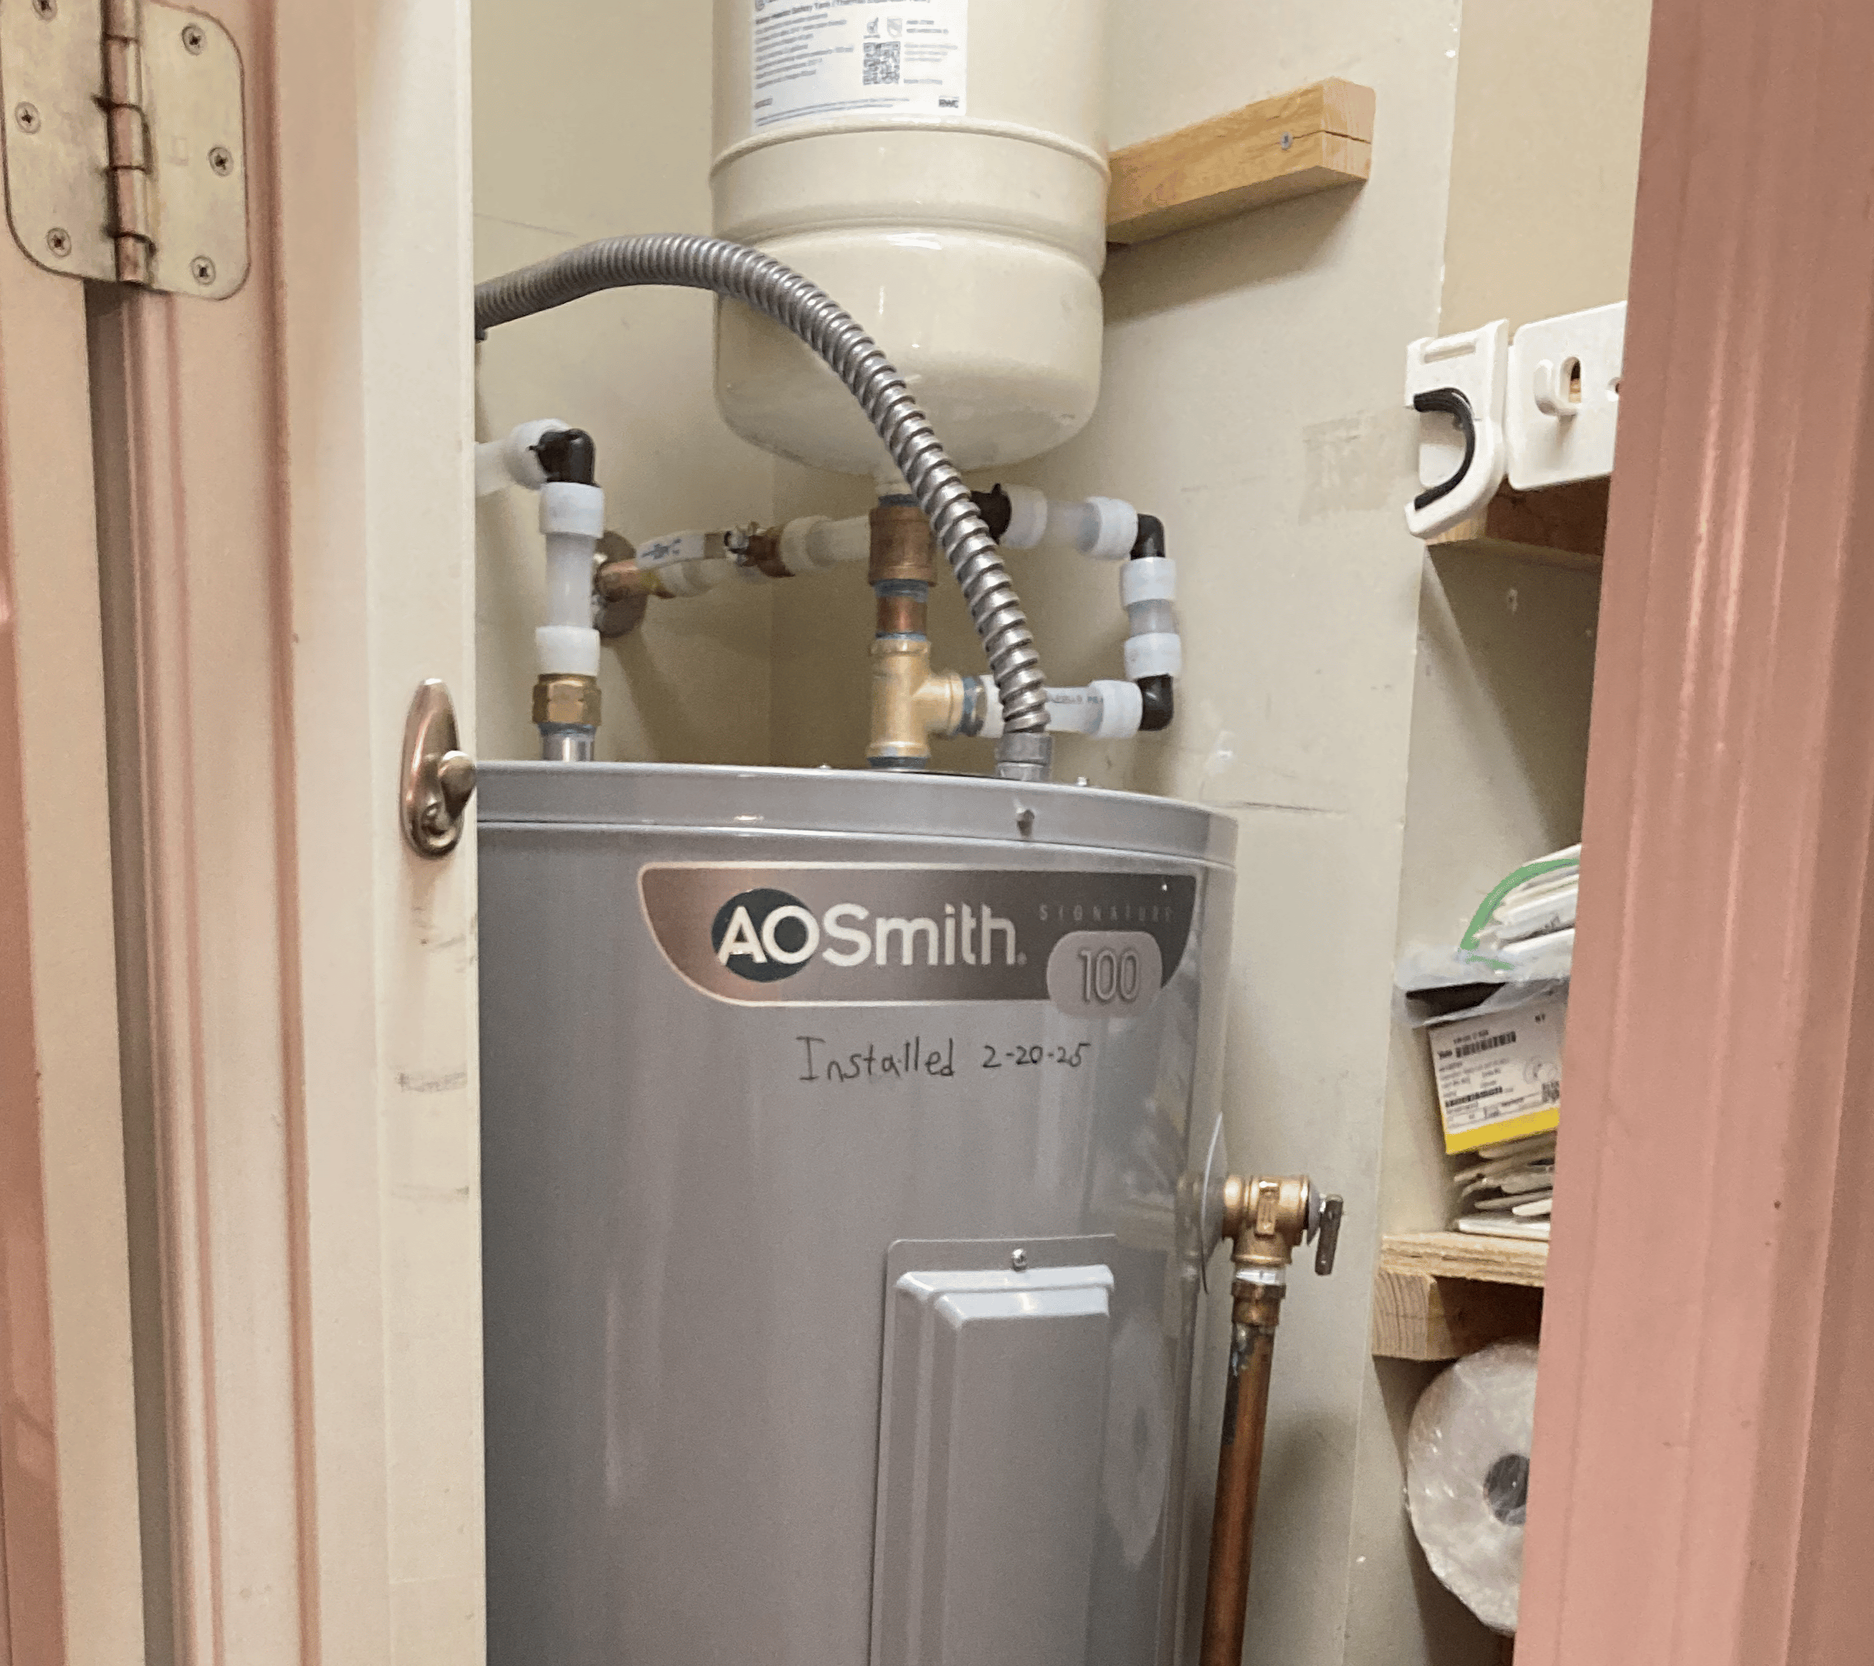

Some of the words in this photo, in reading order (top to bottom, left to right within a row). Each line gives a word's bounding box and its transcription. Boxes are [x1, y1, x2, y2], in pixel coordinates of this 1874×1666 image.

[1077, 947, 1140, 1004] 100
[795, 1036, 955, 1082] Installed
[982, 1042, 1092, 1068] 2-20-25
